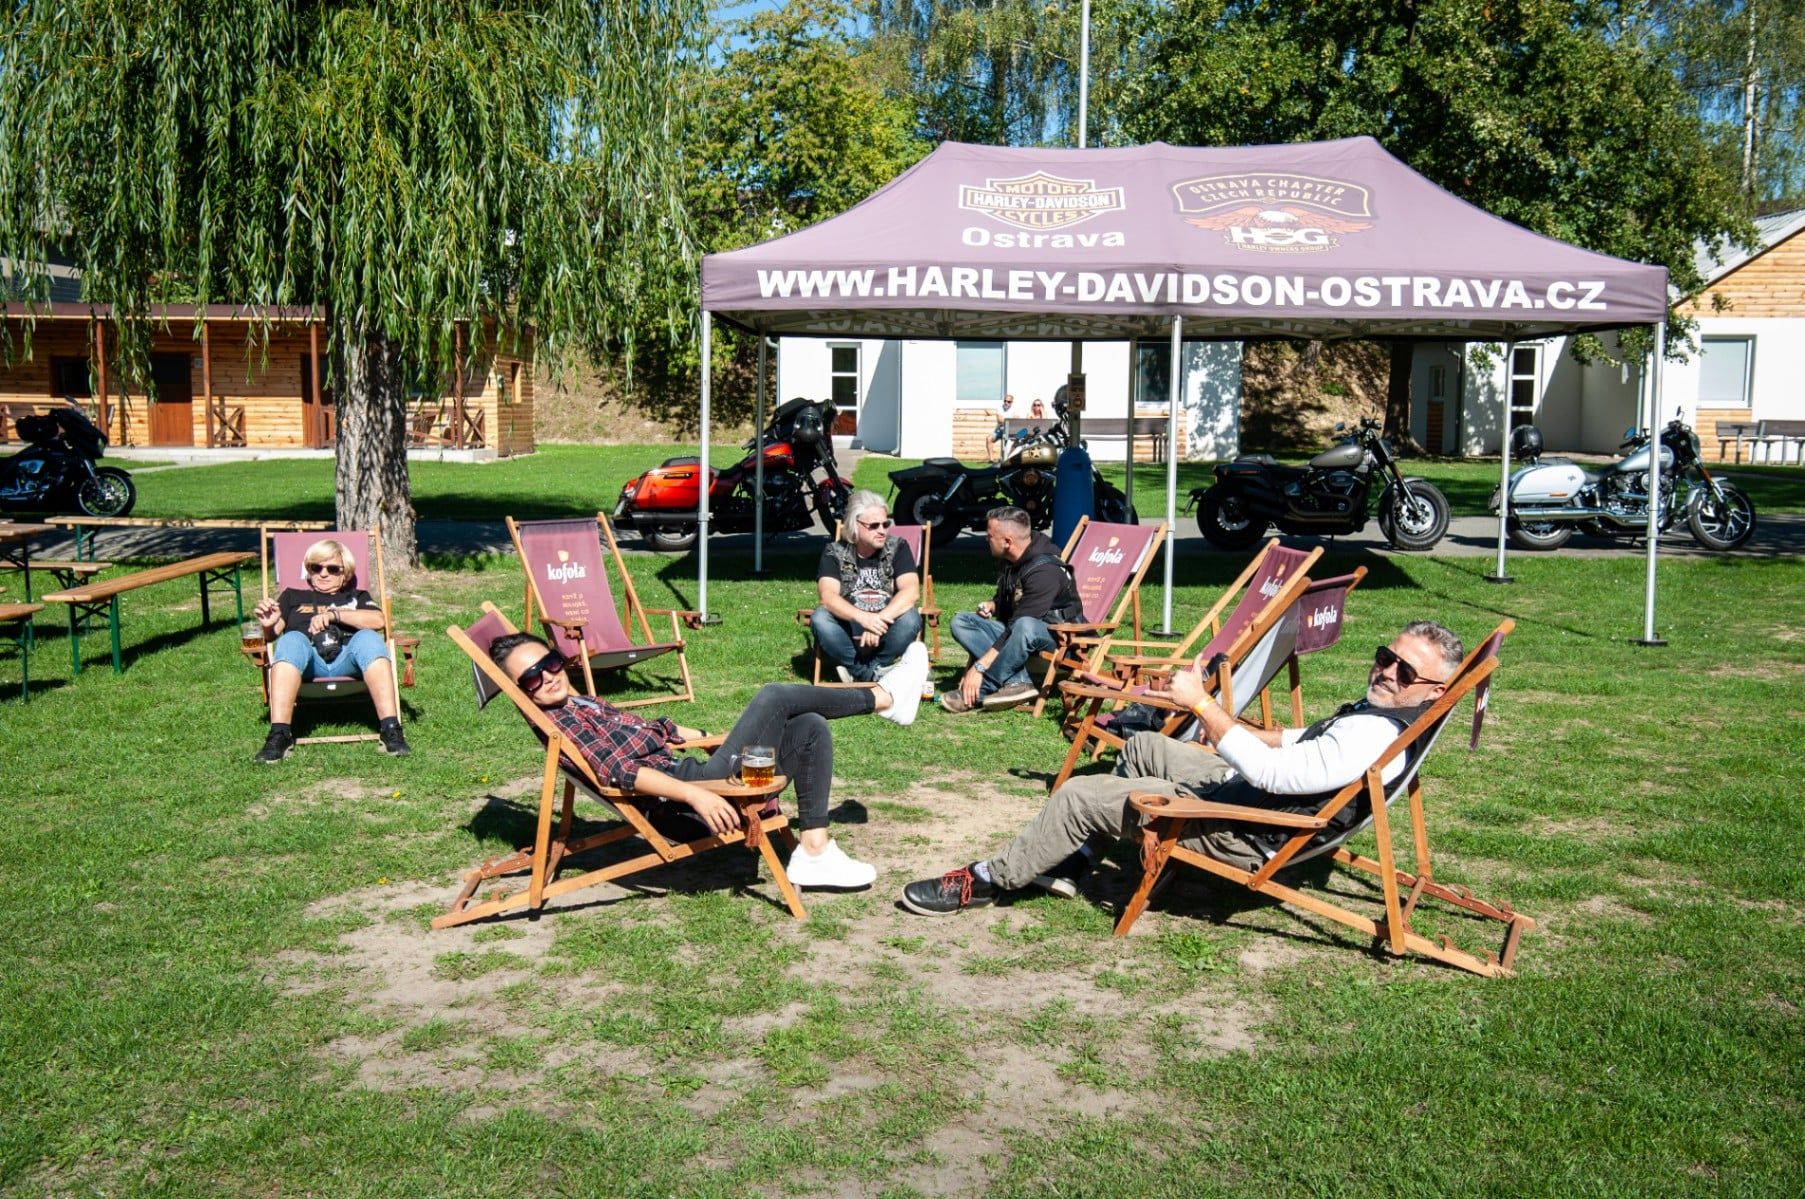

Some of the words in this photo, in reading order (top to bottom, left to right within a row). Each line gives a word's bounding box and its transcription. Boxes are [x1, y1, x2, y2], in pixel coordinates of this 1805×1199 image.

[1006, 181, 1077, 194] MOTOR
[1189, 179, 1261, 194] OSTRAVA
[1267, 179, 1346, 195] CHAPTER
[973, 191, 1111, 209] HARLEY-DAVIDSON
[1200, 190, 1250, 203] CZECH
[1255, 189, 1343, 205] REPUBLIC
[1004, 210, 1078, 226] CYCLES
[962, 227, 1126, 249] Ostrava
[757, 266, 1607, 310] WWW.HARLEY-DAVIDSON-OSTRAVA.CZ
[1088, 546, 1124, 567] kofola
[547, 562, 586, 585] kofola
[1313, 604, 1338, 631] kofola
